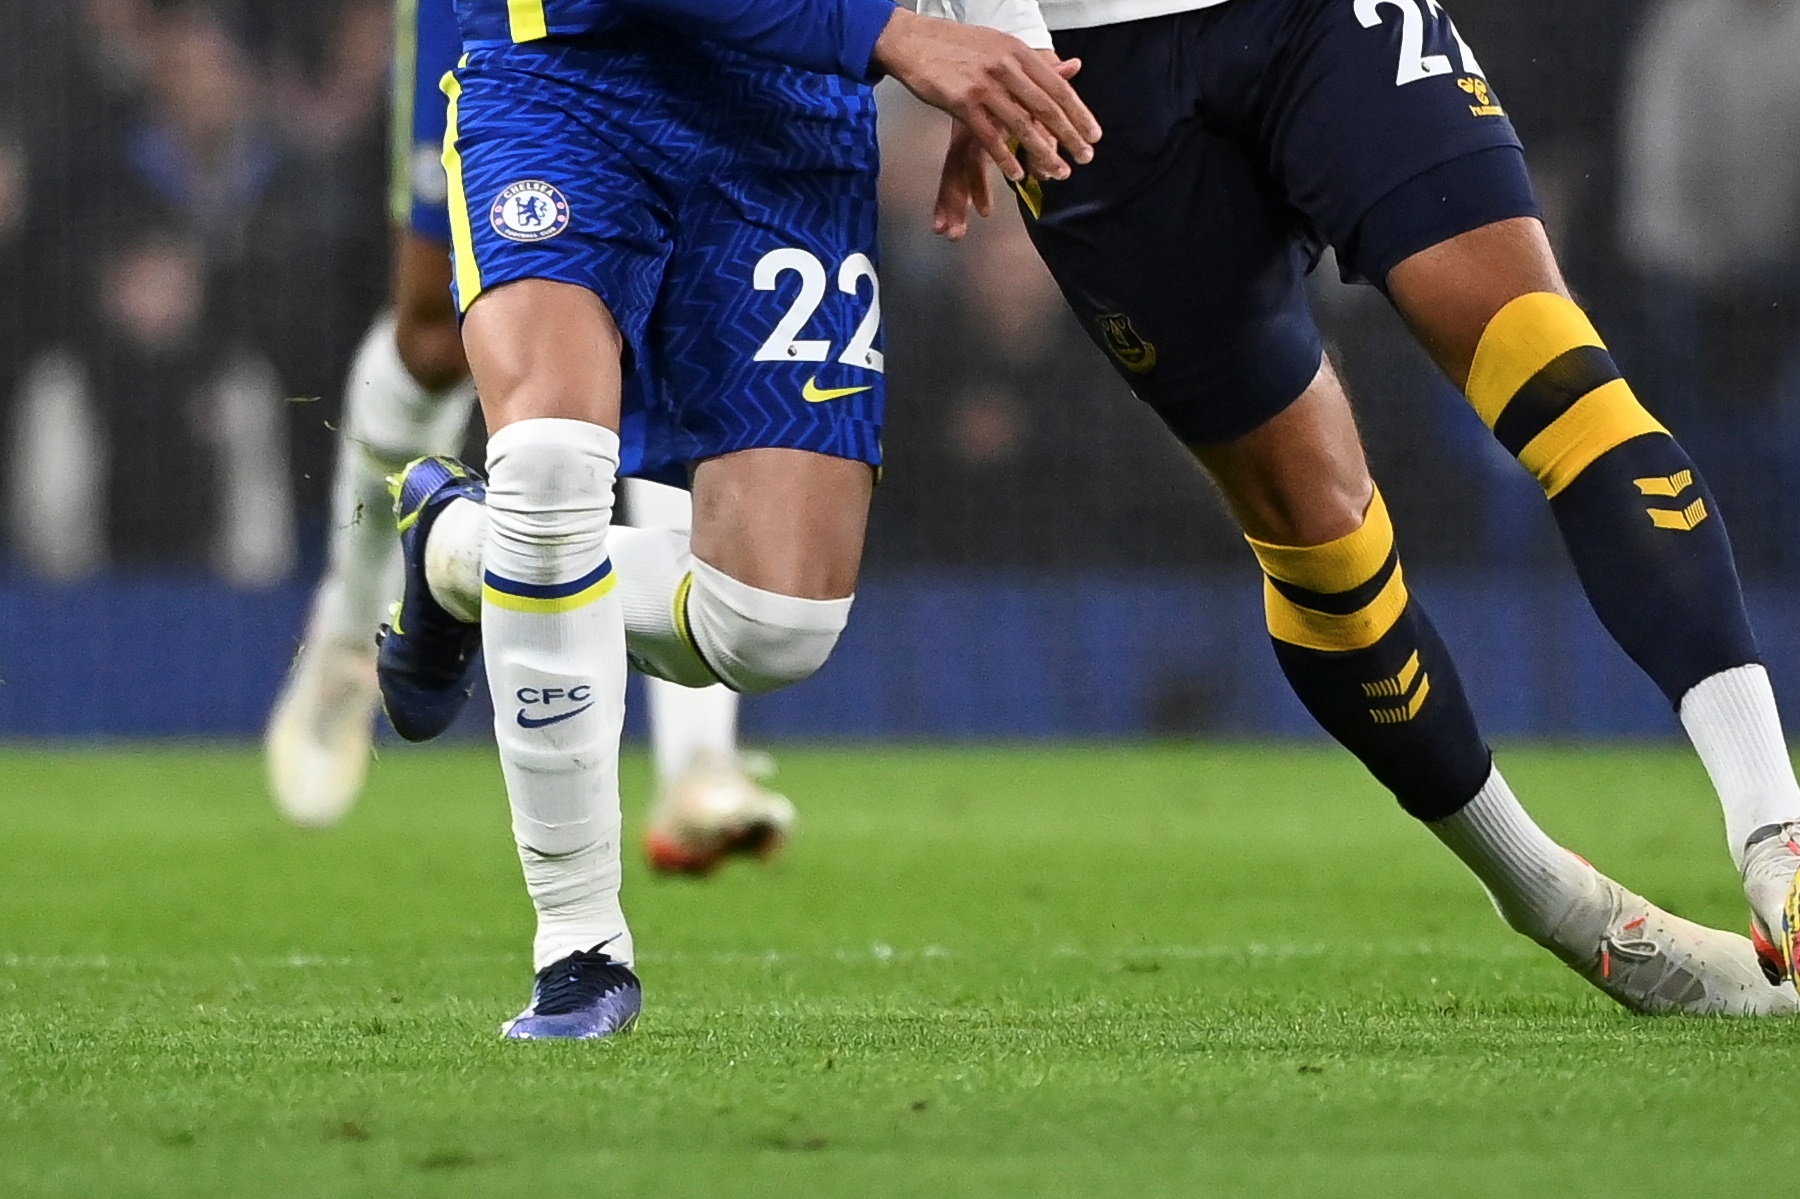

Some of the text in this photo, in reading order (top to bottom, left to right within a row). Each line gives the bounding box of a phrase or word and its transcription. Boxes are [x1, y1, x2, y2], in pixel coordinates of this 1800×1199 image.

[503, 182, 553, 198] CHELSEA
[753, 248, 884, 373] 22
[517, 685, 591, 704] CFC
